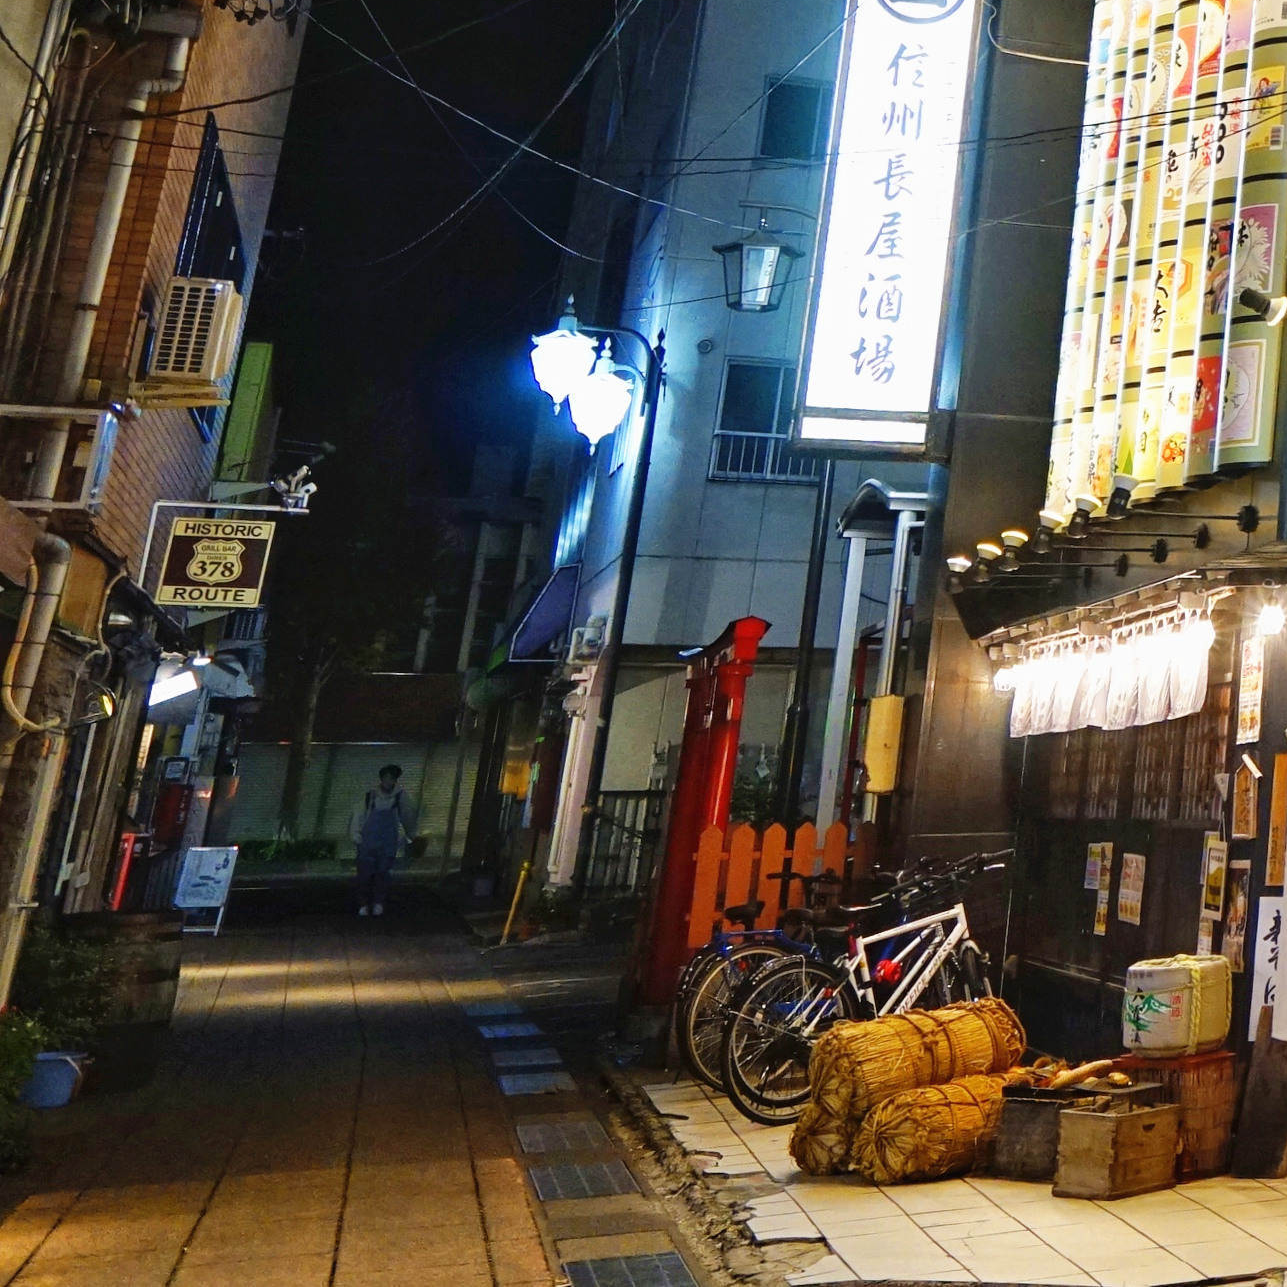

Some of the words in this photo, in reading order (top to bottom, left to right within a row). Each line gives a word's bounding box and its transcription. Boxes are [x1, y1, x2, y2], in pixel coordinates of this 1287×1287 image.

[848, 42, 930, 384] 信州長屋酒場
[184, 522, 263, 538] HISTORIC
[222, 545, 238, 553] BAR
[193, 560, 235, 578] 378
[173, 587, 246, 602] ROUTE
